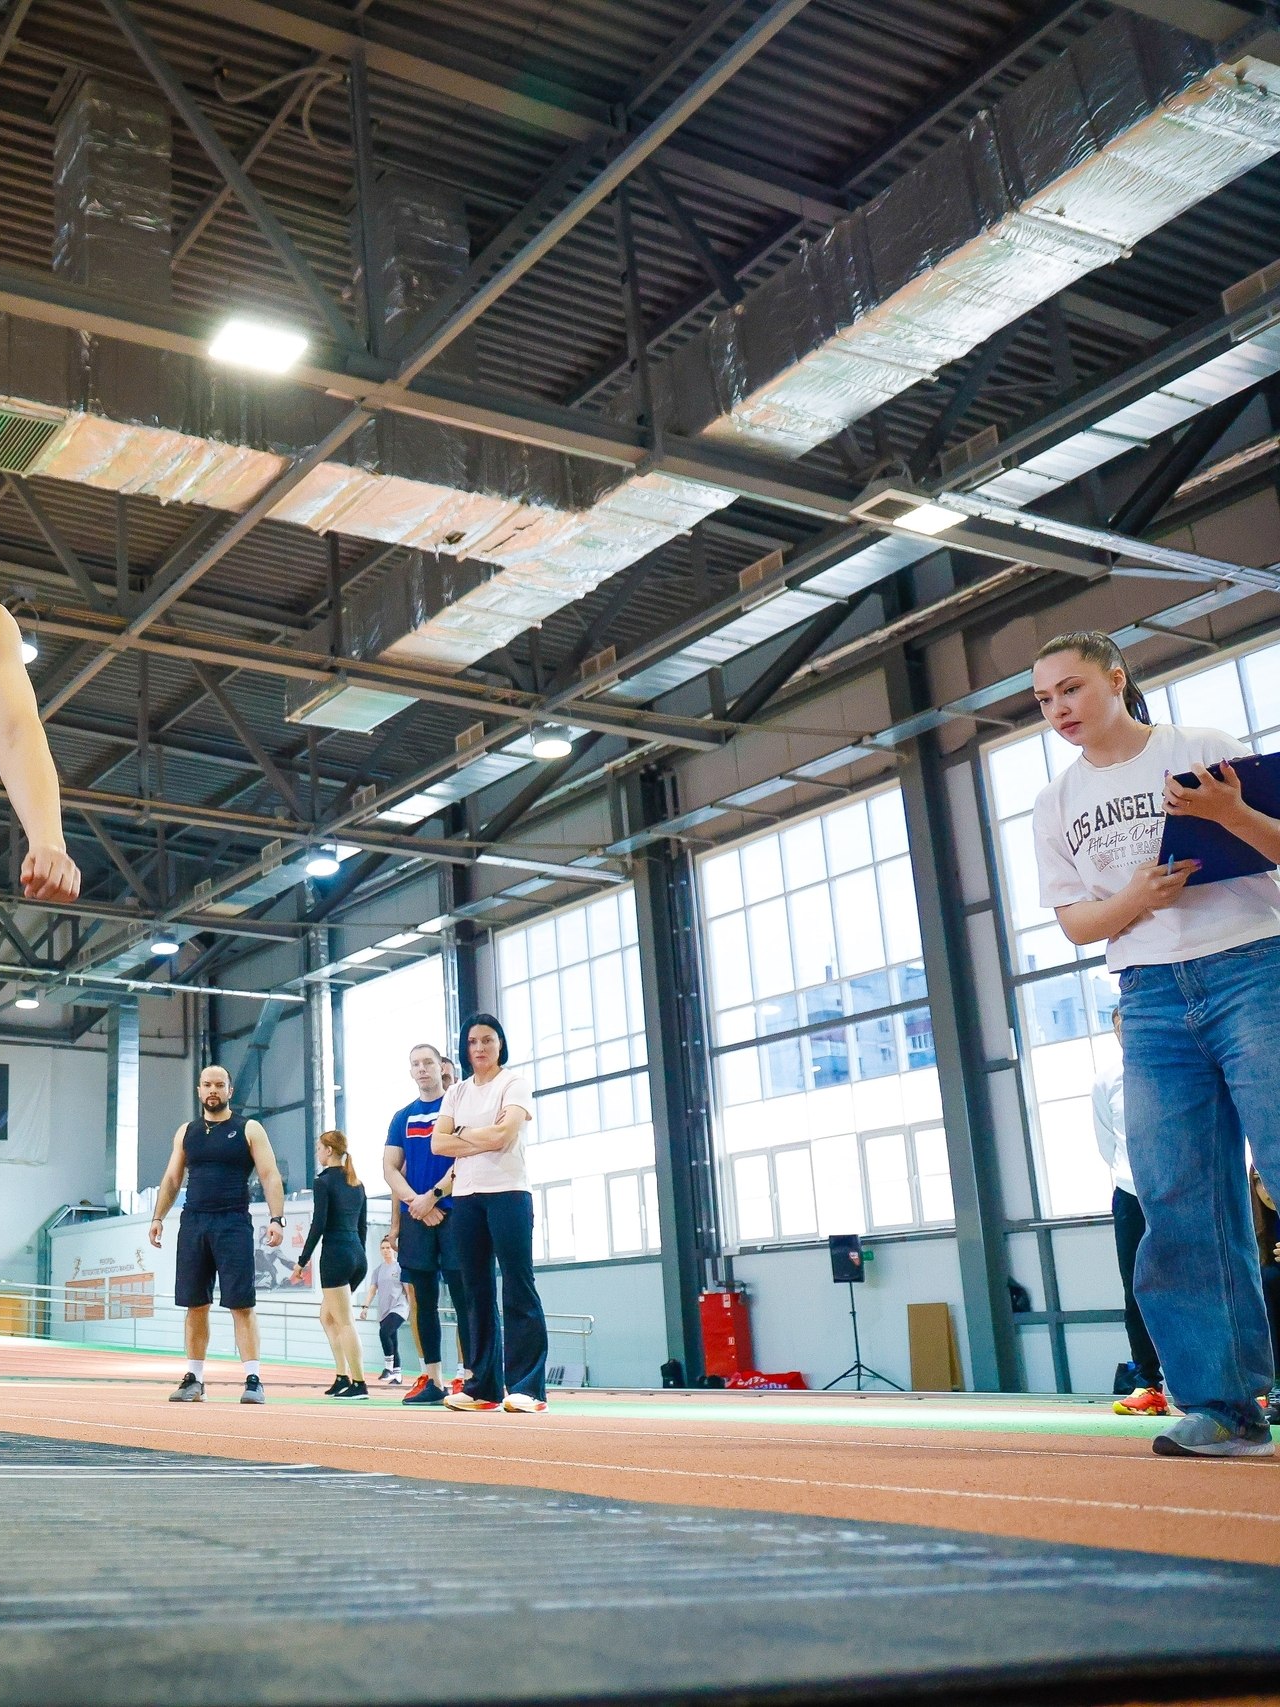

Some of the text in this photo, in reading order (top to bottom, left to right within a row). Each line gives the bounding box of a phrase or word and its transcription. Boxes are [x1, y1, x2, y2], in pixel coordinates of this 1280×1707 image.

[1066, 792, 1166, 856] LOS ANGEL
[1086, 831, 1128, 855] Athletic
